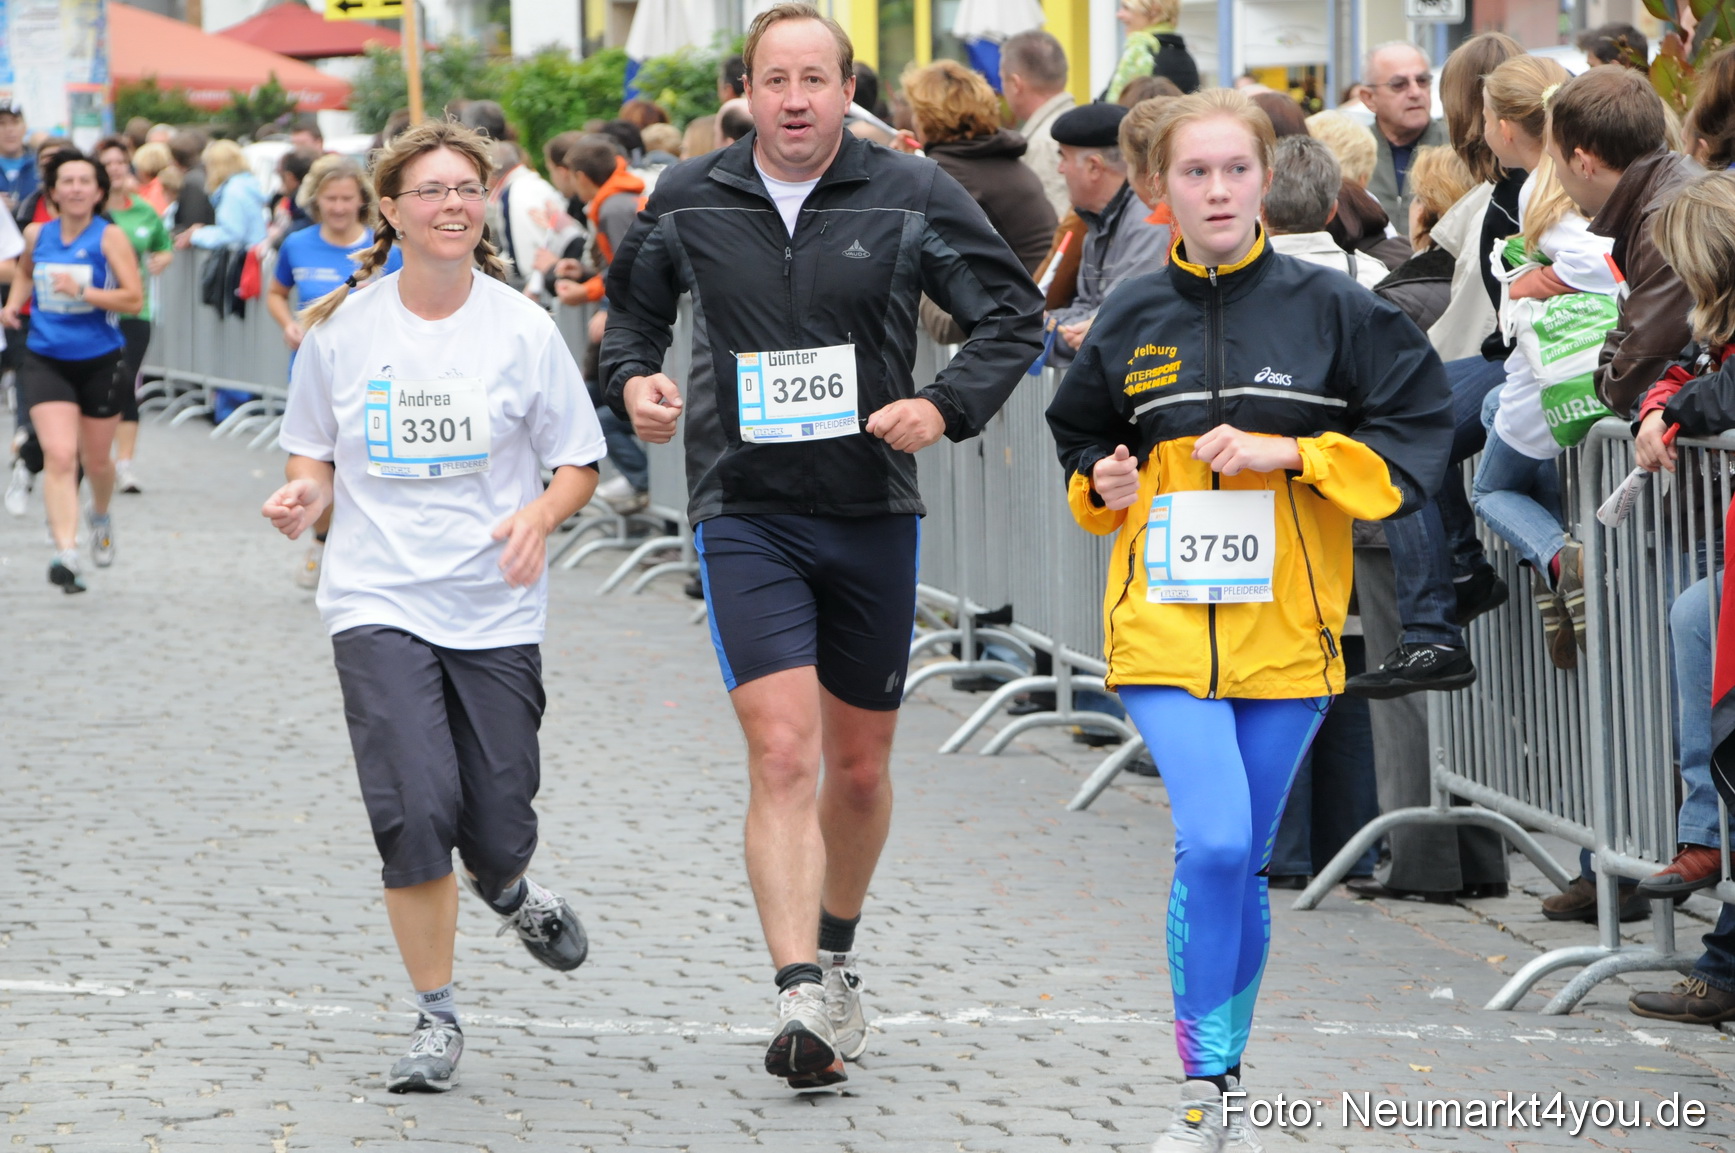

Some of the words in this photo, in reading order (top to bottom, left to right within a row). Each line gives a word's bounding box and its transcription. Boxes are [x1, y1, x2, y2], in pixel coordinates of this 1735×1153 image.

[768, 351, 818, 367] Günter
[745, 378, 752, 391] D
[772, 373, 844, 404] 3266
[398, 389, 451, 407] Andrea
[401, 416, 472, 443] 3301
[814, 417, 856, 430] PFLEIDERER
[442, 459, 488, 470] PFLEIDERER
[1180, 534, 1259, 562] 3750
[1223, 585, 1269, 595] PFLEIDERER
[424, 989, 450, 1003] SOCKS
